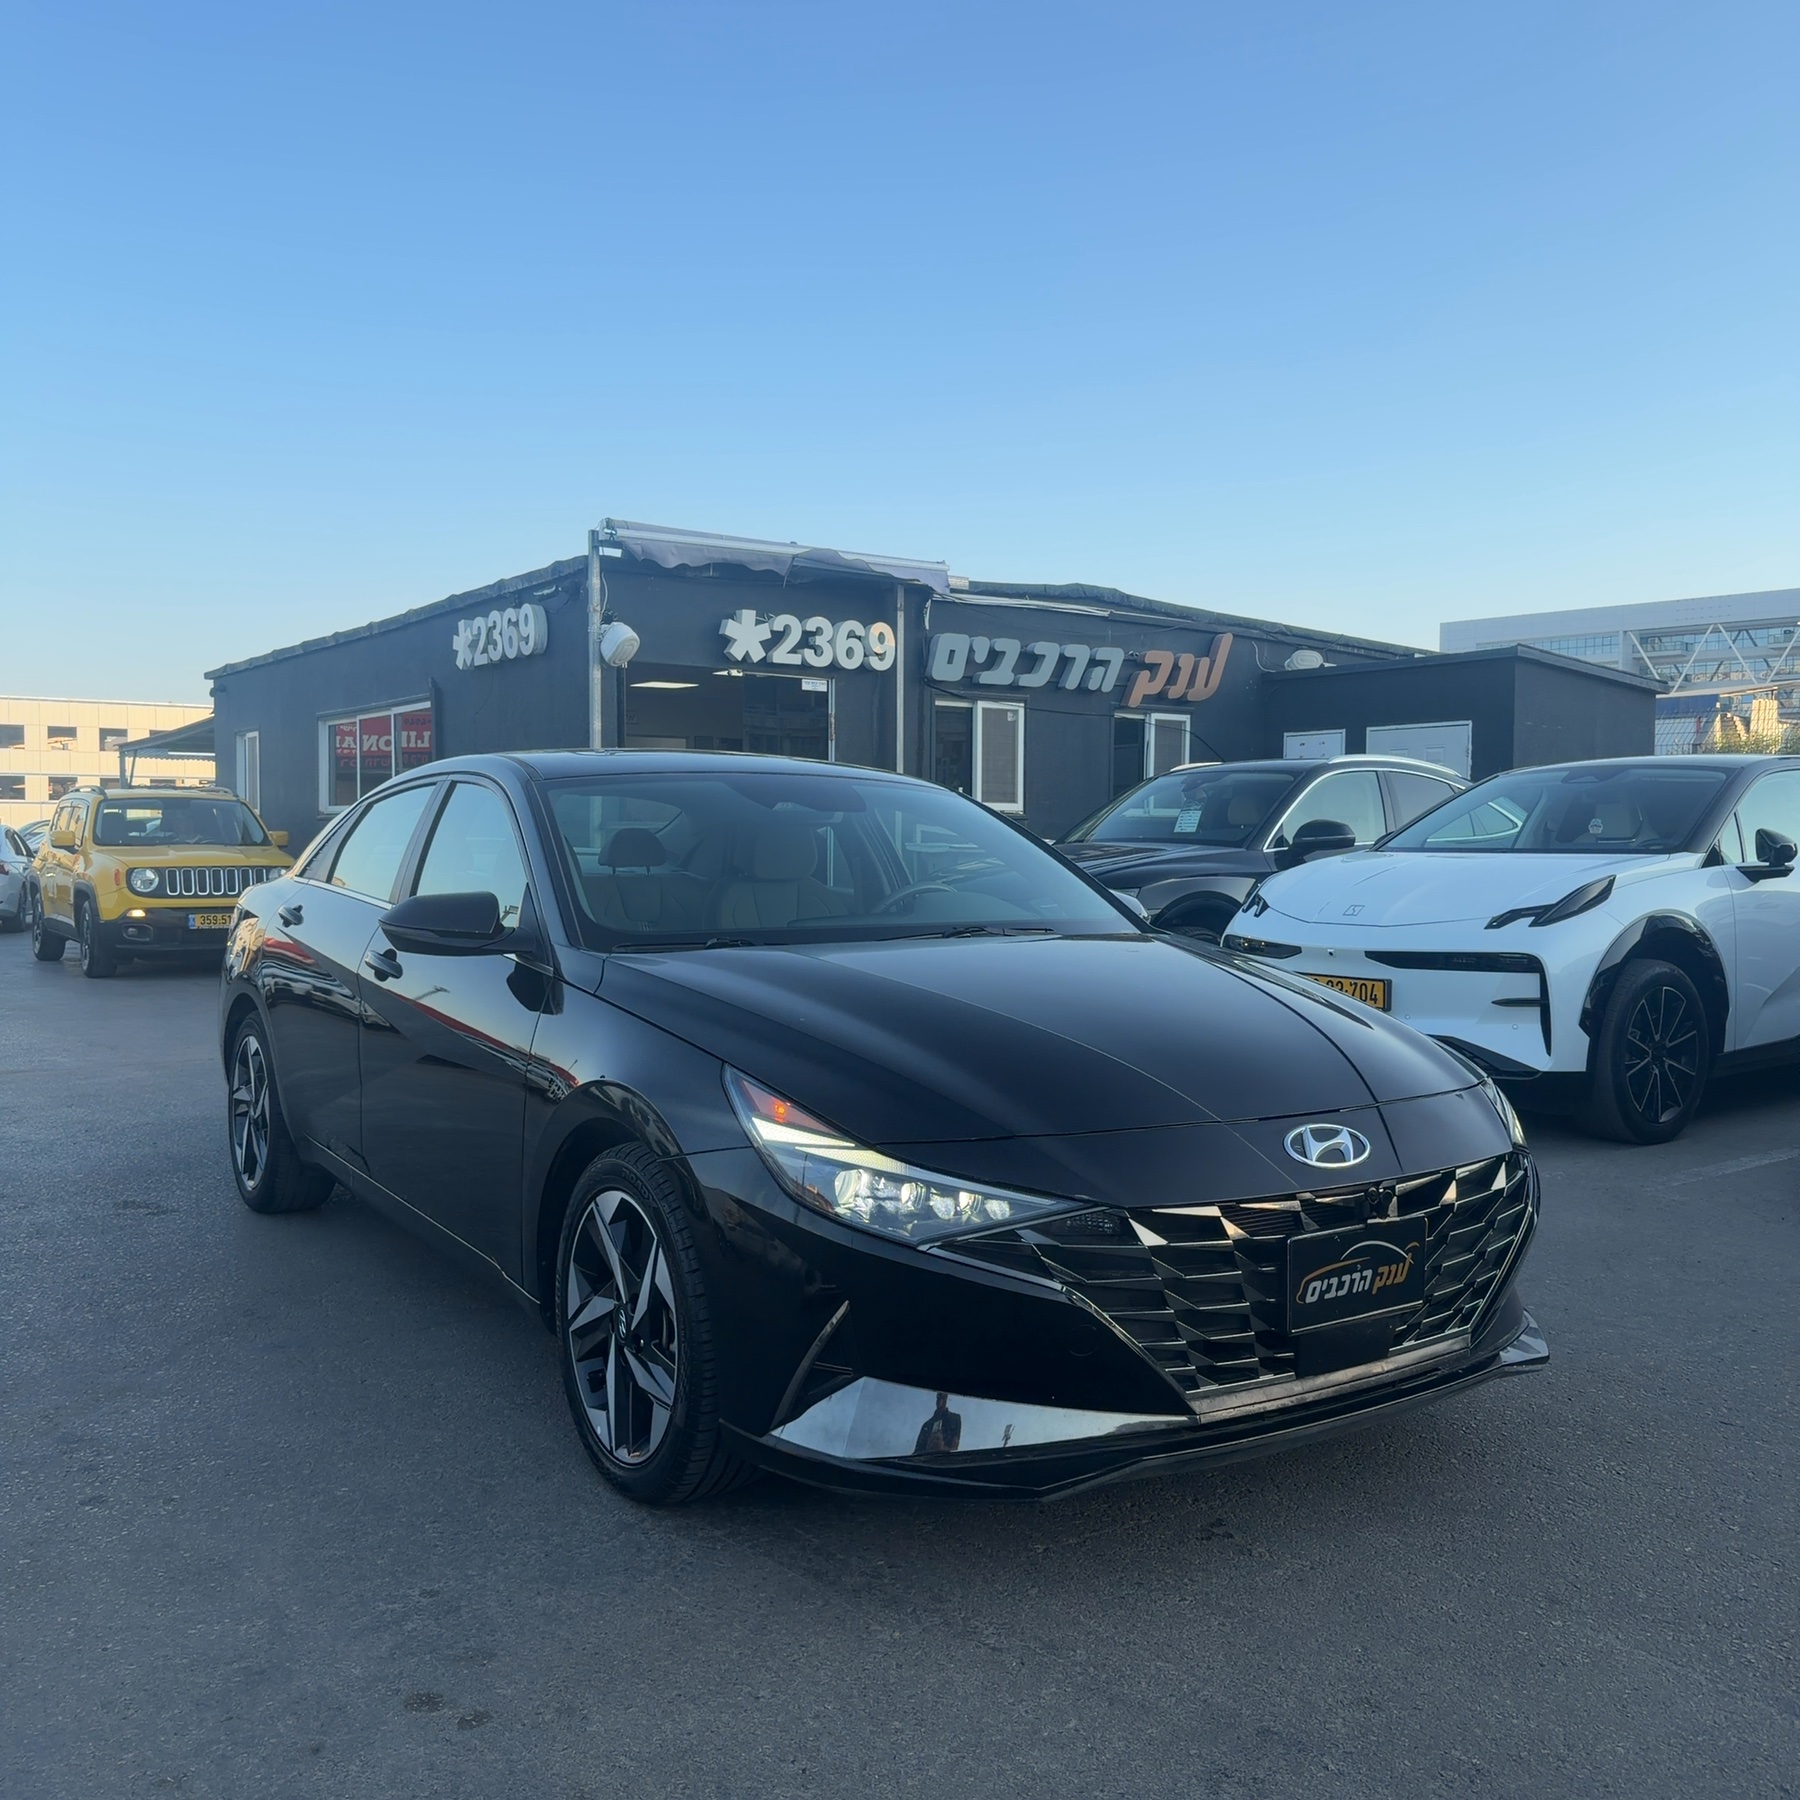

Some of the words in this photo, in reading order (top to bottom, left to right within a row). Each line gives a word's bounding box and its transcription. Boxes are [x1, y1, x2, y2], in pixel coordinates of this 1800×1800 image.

[928, 633, 1124, 693] הרכבים
[1122, 632, 1233, 708] ענק
[1305, 1269, 1373, 1303] הרכבים
[1371, 1252, 1412, 1295] ענק
